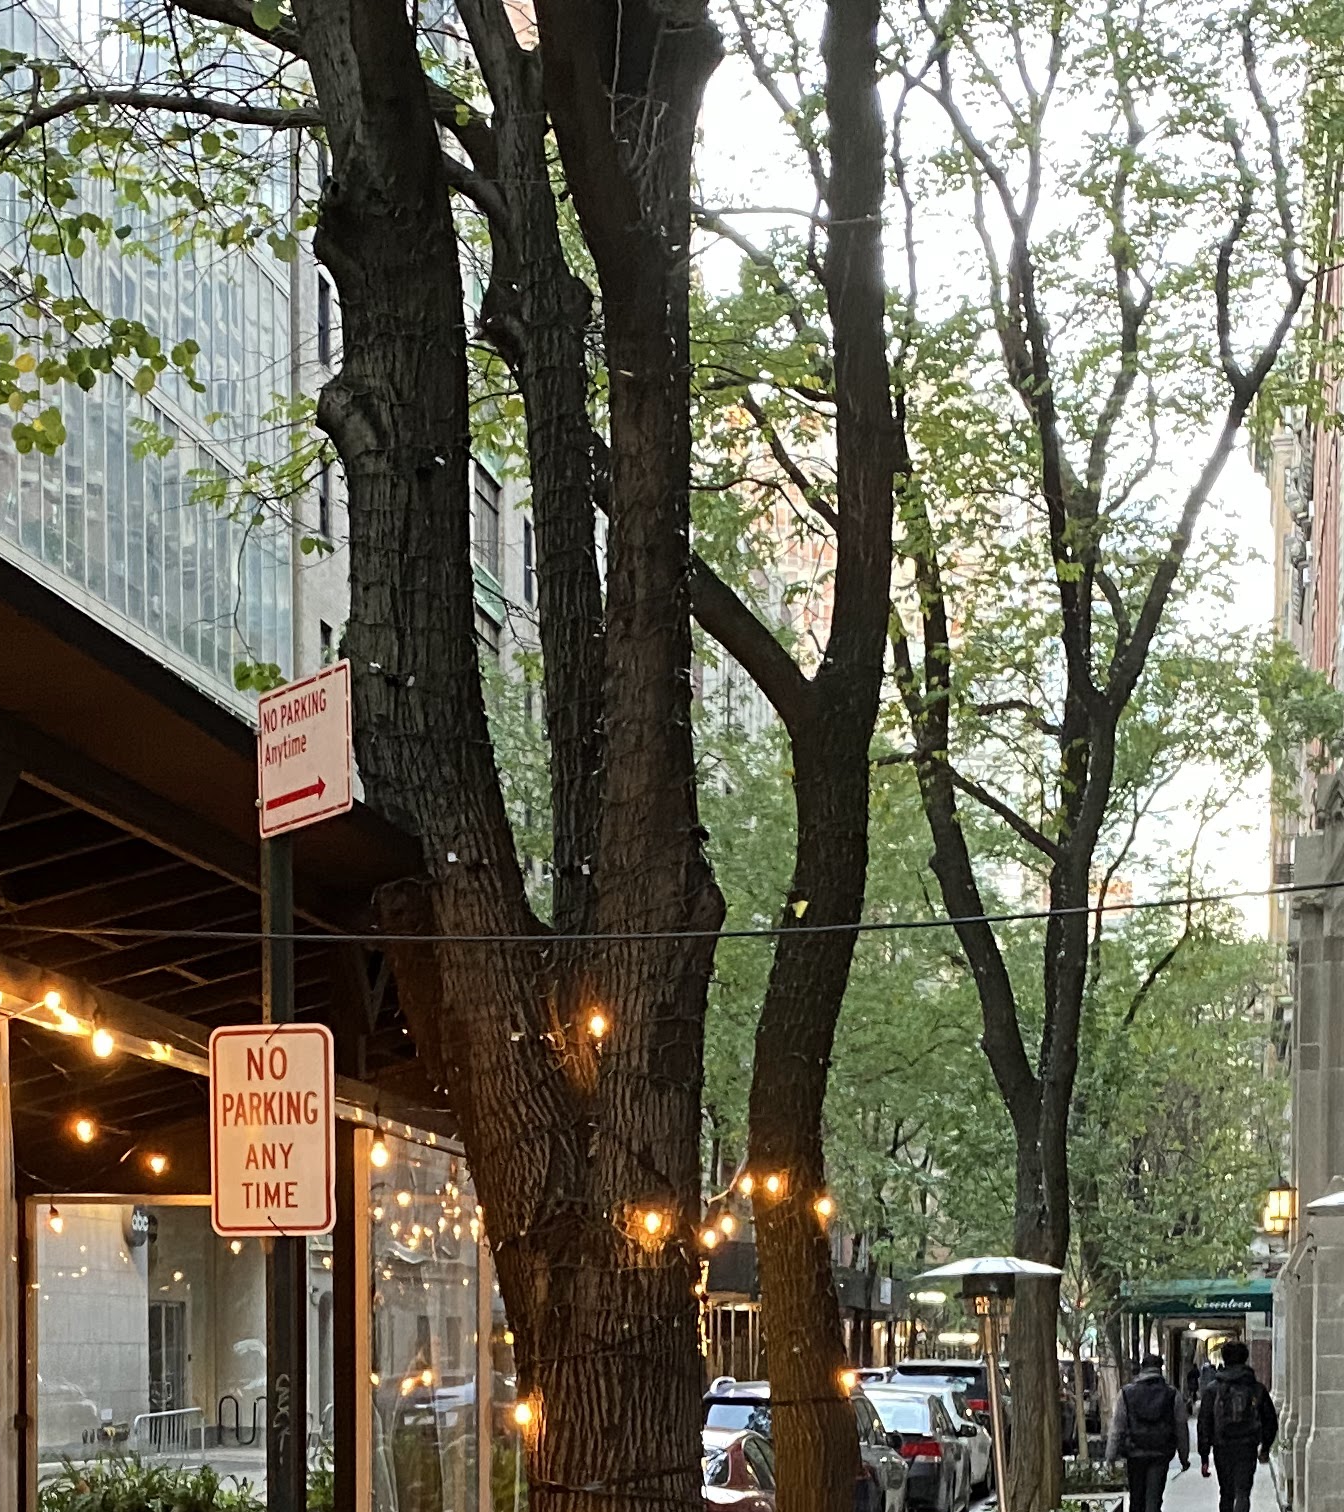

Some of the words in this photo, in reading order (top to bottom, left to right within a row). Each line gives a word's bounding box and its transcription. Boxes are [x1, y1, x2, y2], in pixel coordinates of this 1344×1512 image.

[263, 707, 278, 735] NO
[281, 688, 327, 729] PARKING
[264, 732, 307, 768] Anytime
[247, 1046, 288, 1081] NO
[222, 1090, 319, 1127] PARKING
[245, 1142, 294, 1170] ANY
[242, 1181, 299, 1209] TIME
